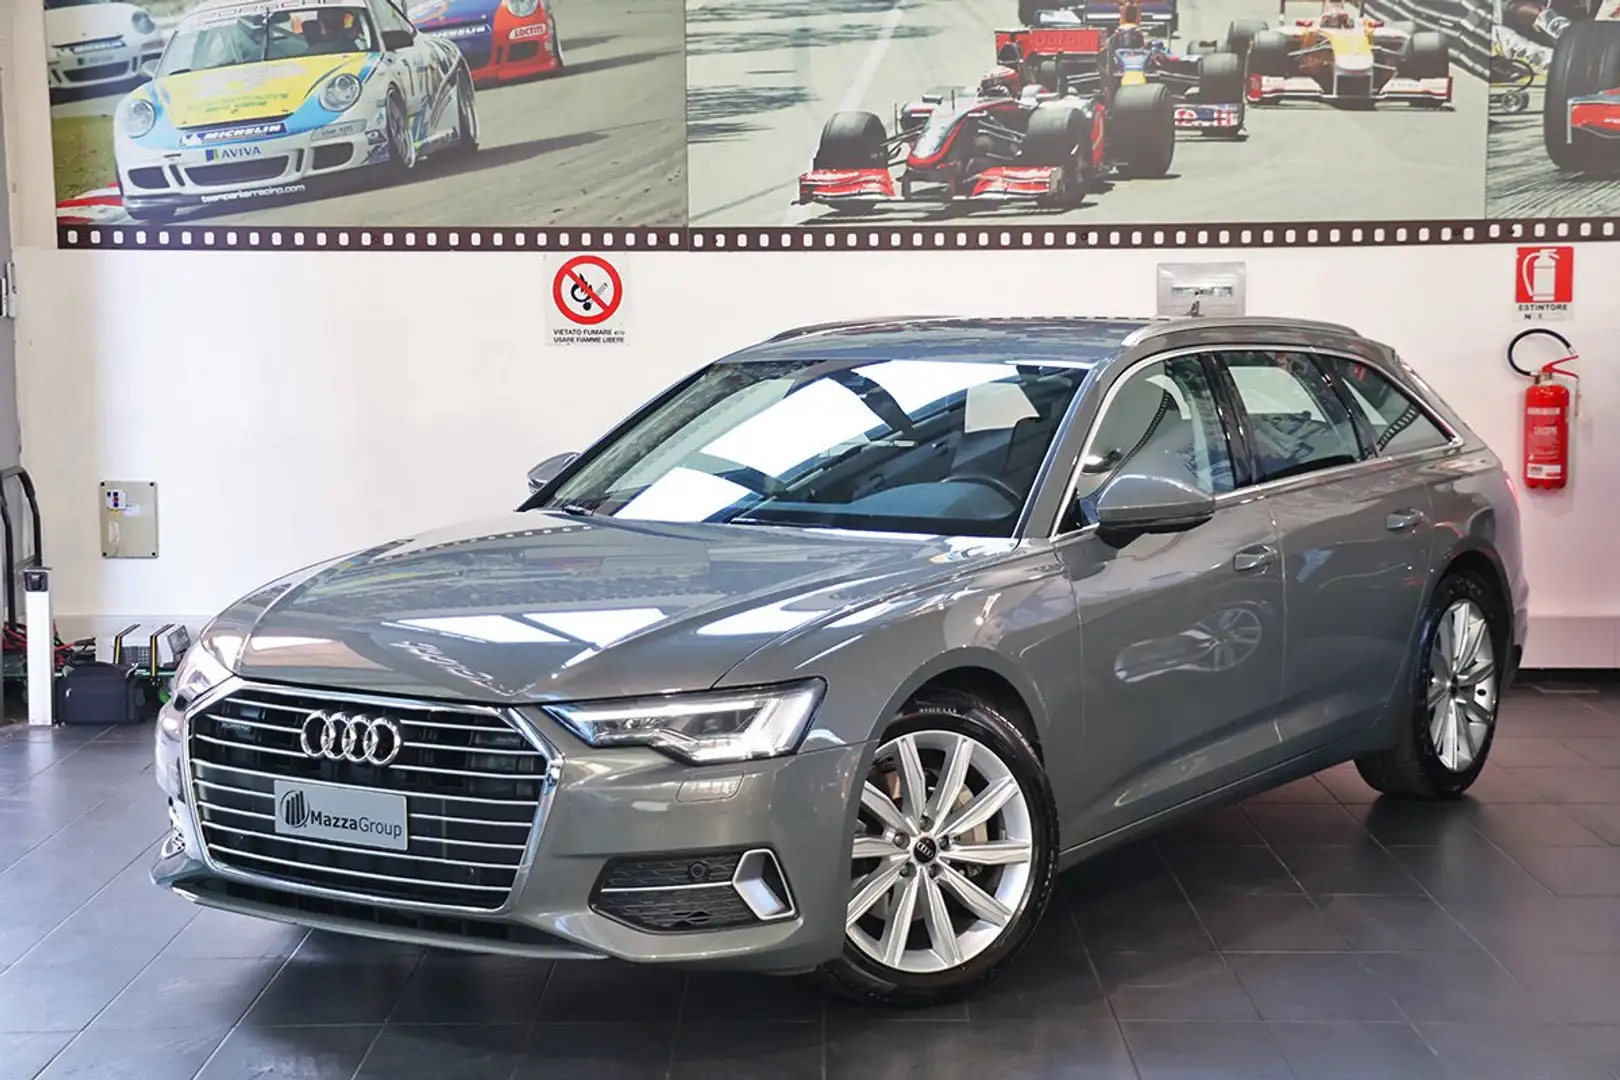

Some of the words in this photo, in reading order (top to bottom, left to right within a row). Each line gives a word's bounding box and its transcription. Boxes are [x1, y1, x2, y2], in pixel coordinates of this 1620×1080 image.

[203, 124, 281, 139] MICHELIN
[221, 146, 262, 160] AVIVA
[1518, 304, 1568, 312] ESTINTORE
[310, 810, 402, 839] MazzaGroup
